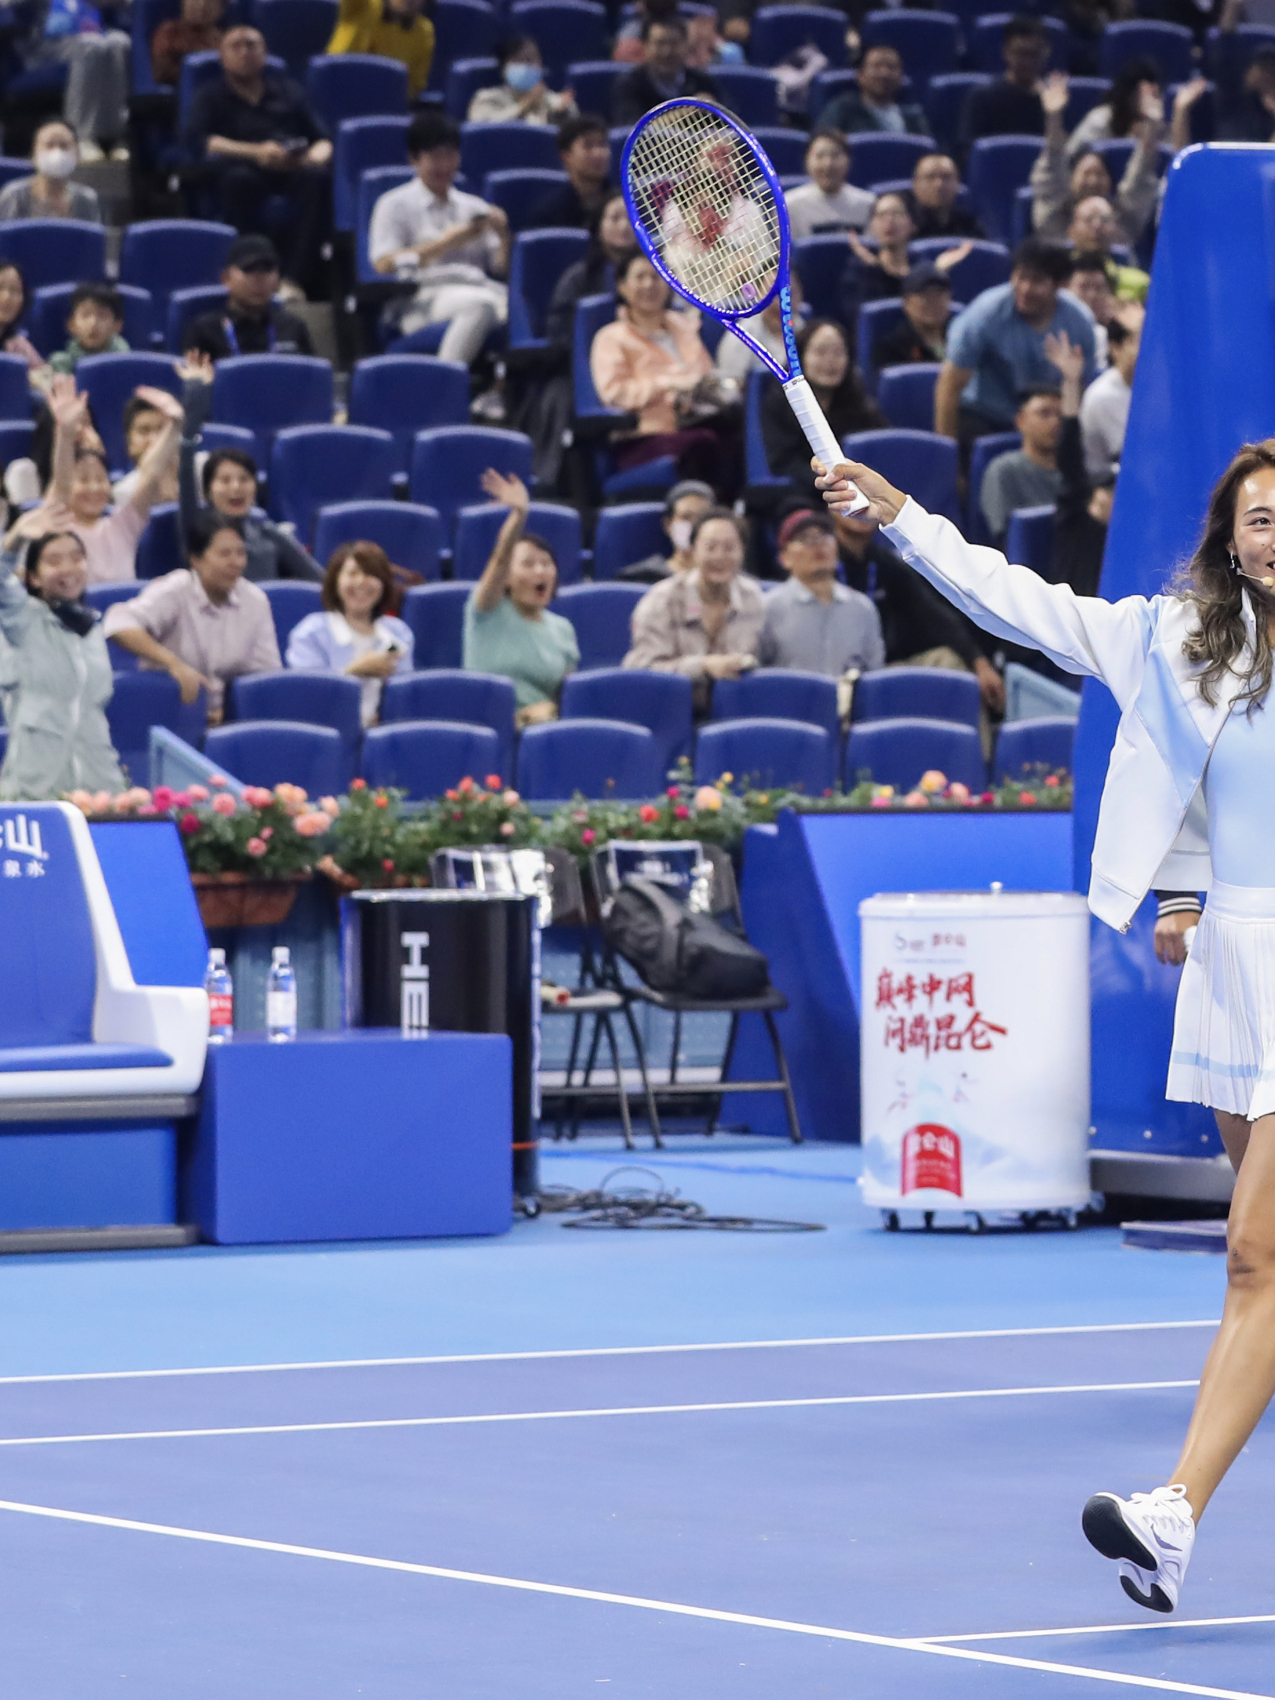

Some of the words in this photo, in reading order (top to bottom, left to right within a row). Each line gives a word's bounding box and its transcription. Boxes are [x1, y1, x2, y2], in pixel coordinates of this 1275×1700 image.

[0, 814, 43, 859] 山
[401, 931, 430, 1026] HE
[876, 968, 974, 1009] 巅峰中网
[885, 1012, 1007, 1059] 问鼎昆仑
